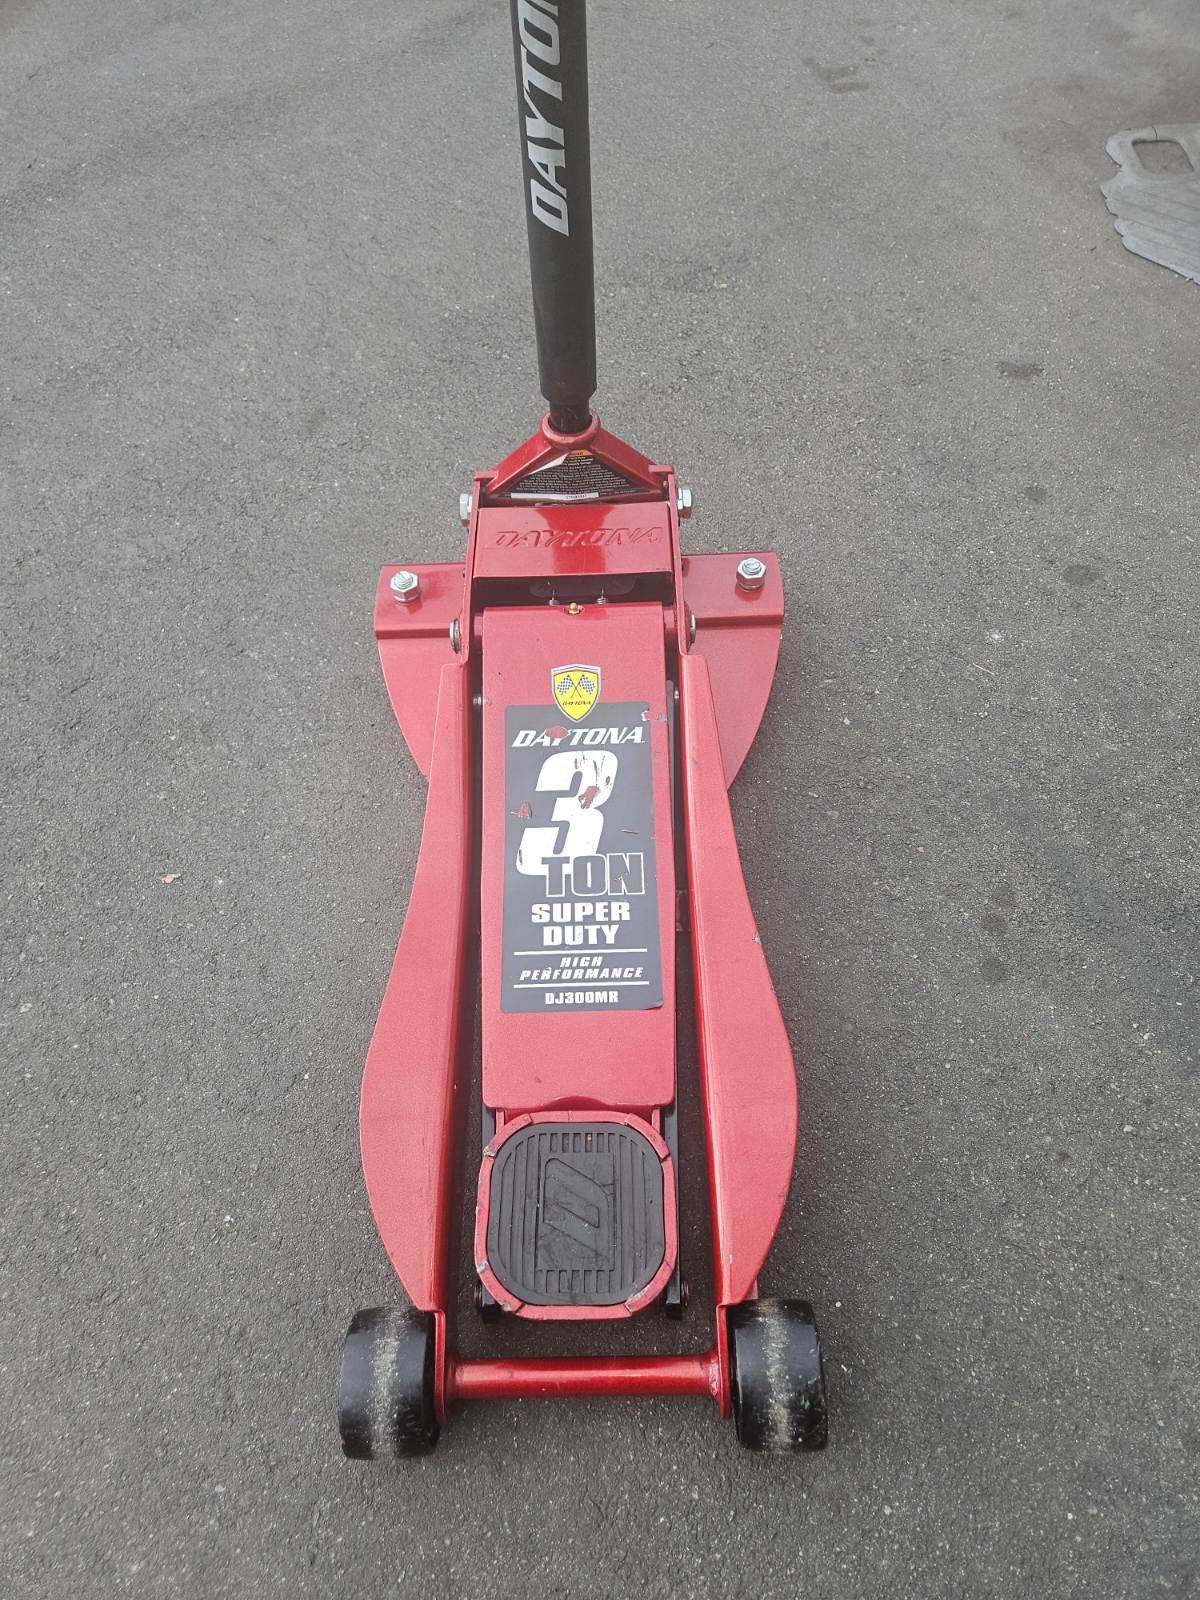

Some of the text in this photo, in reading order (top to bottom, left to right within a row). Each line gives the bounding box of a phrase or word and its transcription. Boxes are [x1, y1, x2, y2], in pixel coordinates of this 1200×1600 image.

[495, 527, 663, 548] DAYTONA
[516, 750, 618, 876] 3
[541, 852, 646, 898] TON
[531, 901, 631, 923] SUPER
[543, 924, 620, 946] DUTY
[560, 956, 603, 968] HIGH
[519, 967, 644, 981] PERFORMANCE
[545, 990, 619, 1005] DJ300MR
